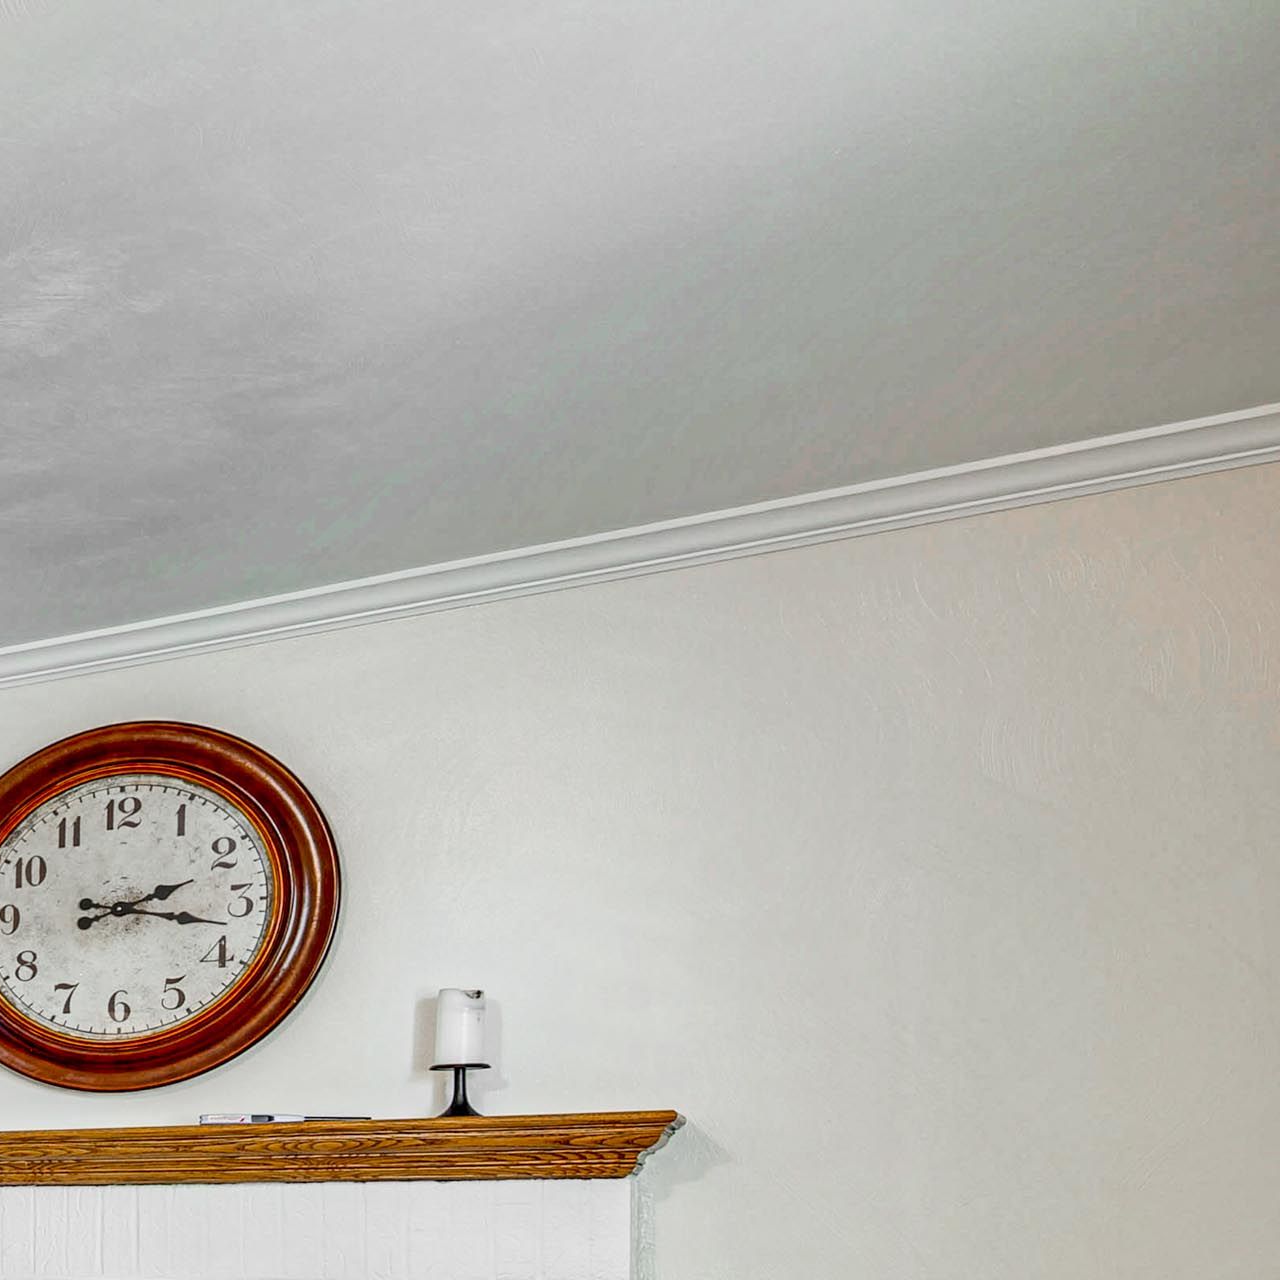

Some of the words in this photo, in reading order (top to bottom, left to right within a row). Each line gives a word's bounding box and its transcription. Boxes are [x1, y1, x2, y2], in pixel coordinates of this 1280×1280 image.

[104, 796, 143, 831] 12
[176, 803, 187, 837] 1
[56, 815, 82, 849] 11
[210, 836, 239, 871] 2
[14, 854, 48, 890] 10
[227, 882, 255, 918] 3
[14, 950, 39, 982] 8
[199, 935, 235, 969] 4
[53, 982, 80, 1015] 7
[107, 989, 132, 1023] 6
[160, 975, 187, 1011] 5
